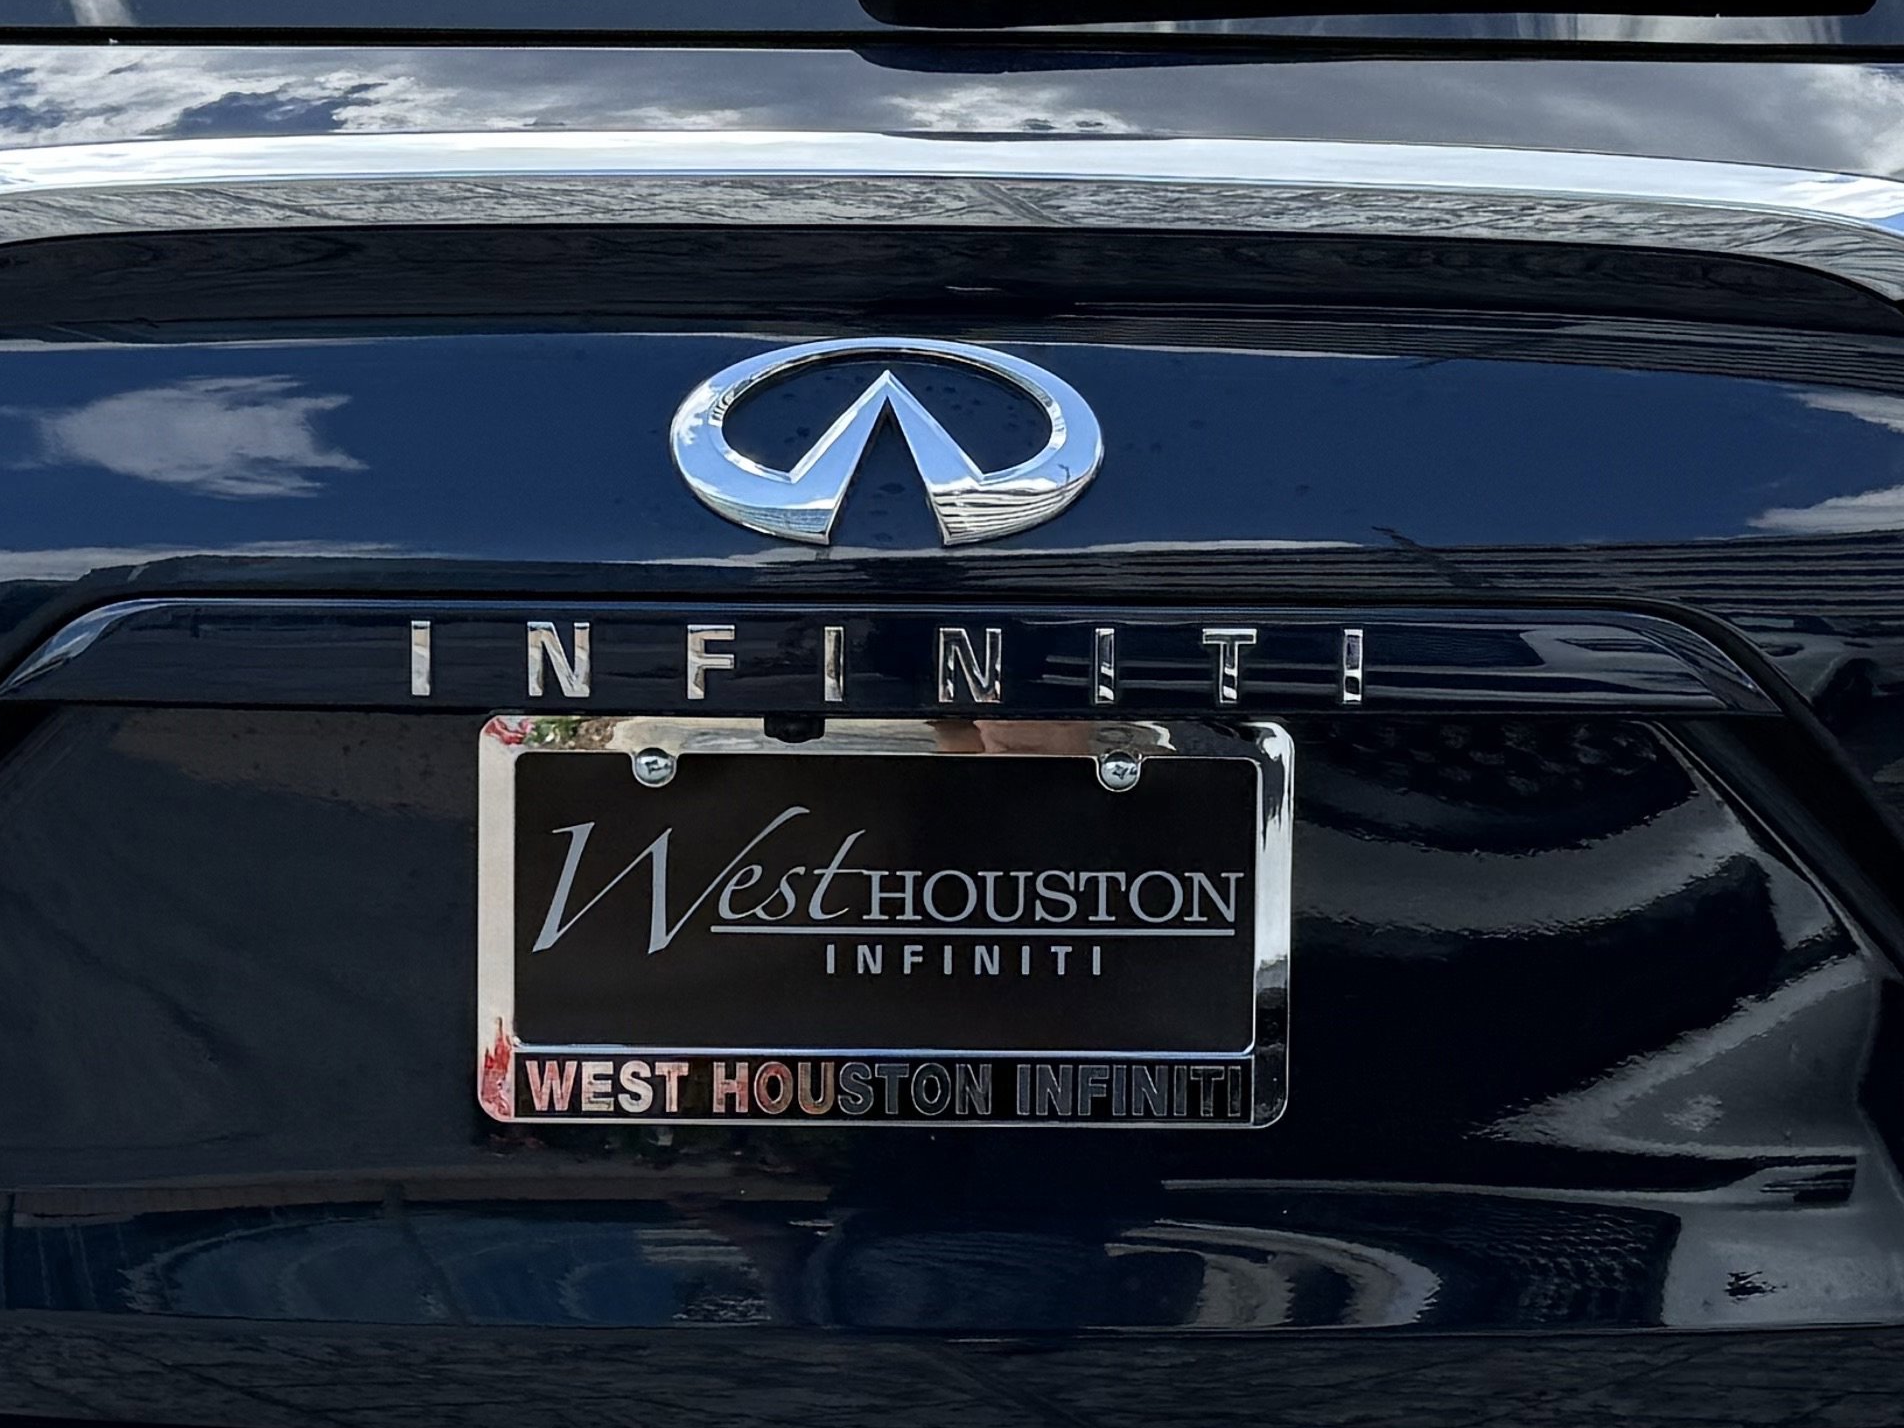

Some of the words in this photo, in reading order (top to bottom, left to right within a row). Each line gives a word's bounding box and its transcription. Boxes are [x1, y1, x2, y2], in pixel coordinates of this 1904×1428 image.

[410, 618, 1366, 705] INFINITI
[867, 869, 1245, 924] HOUSTON
[825, 943, 1103, 976] INFINITI
[524, 1058, 689, 1115] WEST
[712, 1059, 992, 1117] HOUSTON
[1015, 1062, 1242, 1119] INFINITI
